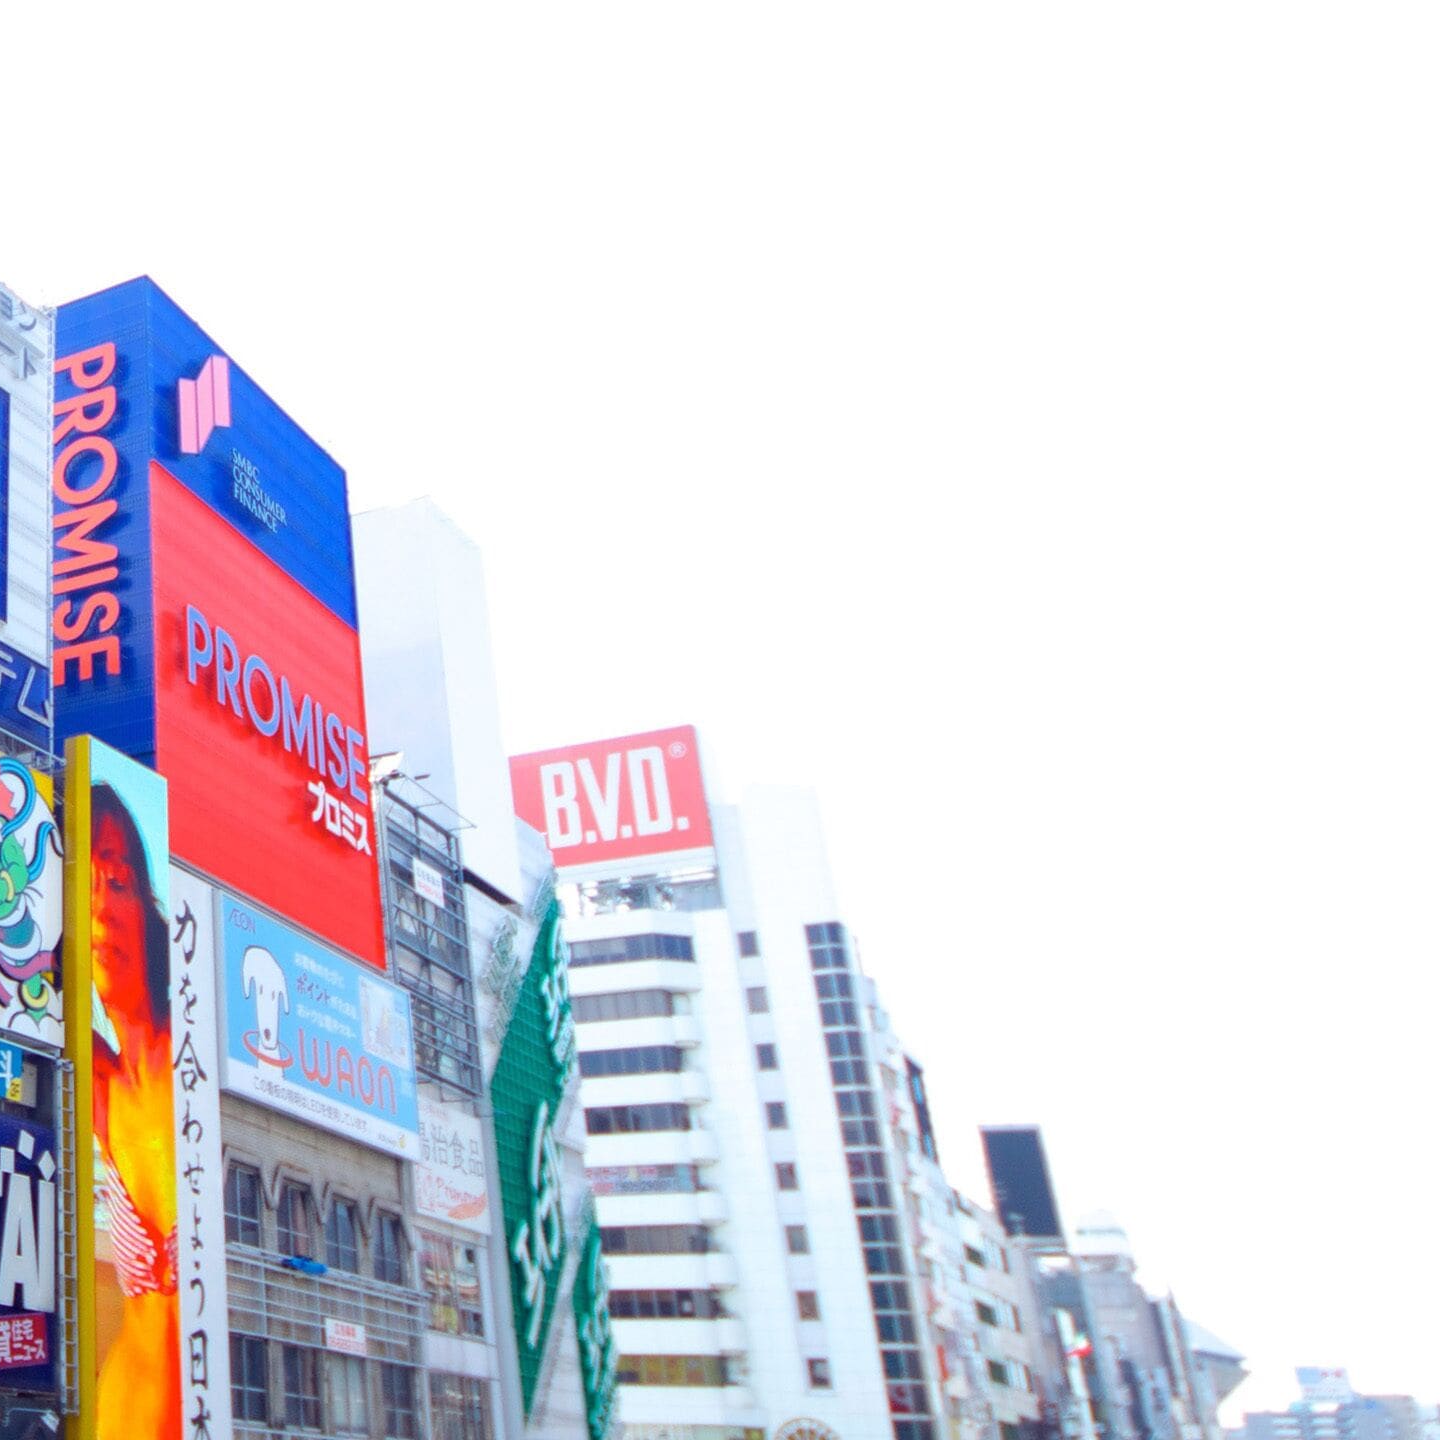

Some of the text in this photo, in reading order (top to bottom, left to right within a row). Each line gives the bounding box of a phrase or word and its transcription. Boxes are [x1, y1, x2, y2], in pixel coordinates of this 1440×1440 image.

[232, 447, 261, 485] SMBC
[233, 465, 288, 527] CONSUMER
[52, 341, 121, 688] PROMISE
[233, 480, 278, 534] FINANCE
[186, 603, 369, 806] PROMISE
[307, 780, 373, 857] プロミス
[539, 746, 691, 850] B.V.D.
[299, 1027, 397, 1117] WAON
[172, 899, 213, 1440] 力を合わせよう日本
[12, 1319, 35, 1342] 住宅
[12, 1339, 47, 1362] ニュース
